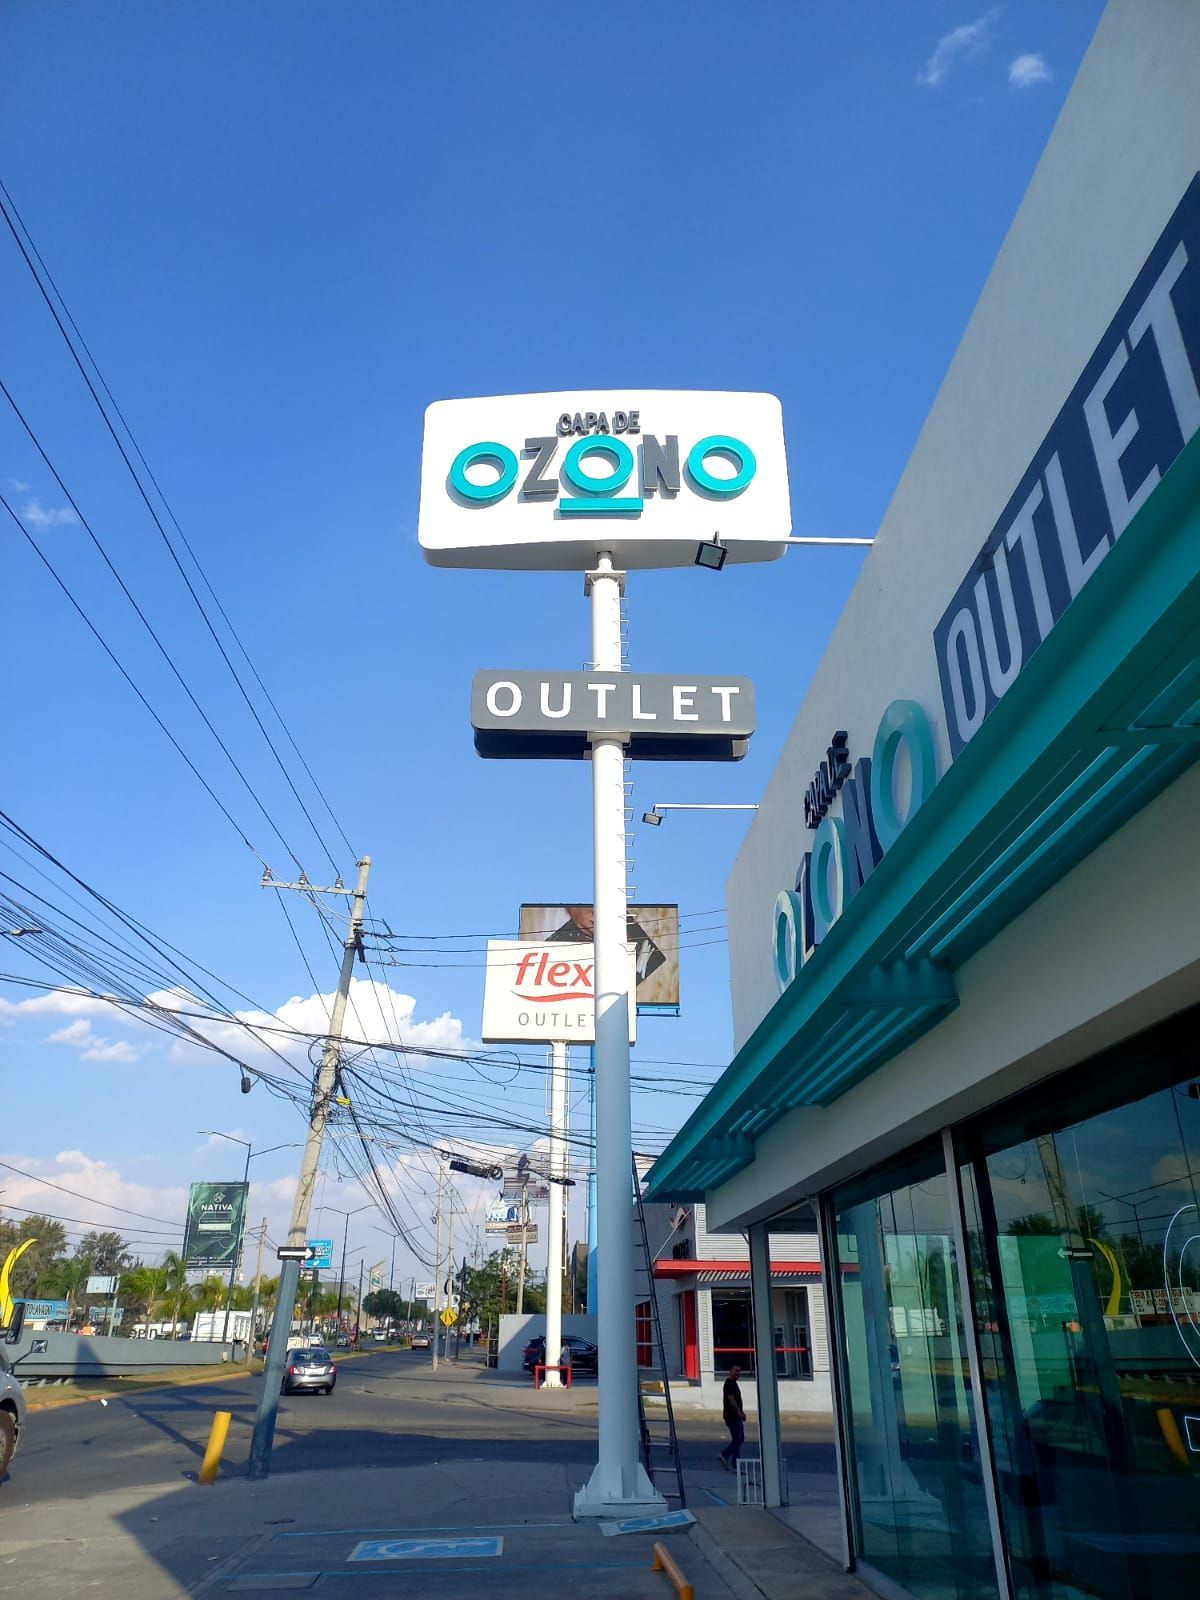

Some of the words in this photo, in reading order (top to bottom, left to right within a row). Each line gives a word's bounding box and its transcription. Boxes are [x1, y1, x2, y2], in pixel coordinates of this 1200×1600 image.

[558, 412, 610, 436] CAPA
[614, 410, 641, 434] DE
[450, 433, 757, 503] OZONO
[946, 240, 1200, 743] OUTLET
[485, 681, 740, 723] OUTLET
[514, 952, 594, 987] flex
[201, 1203, 233, 1211] NATIVA
